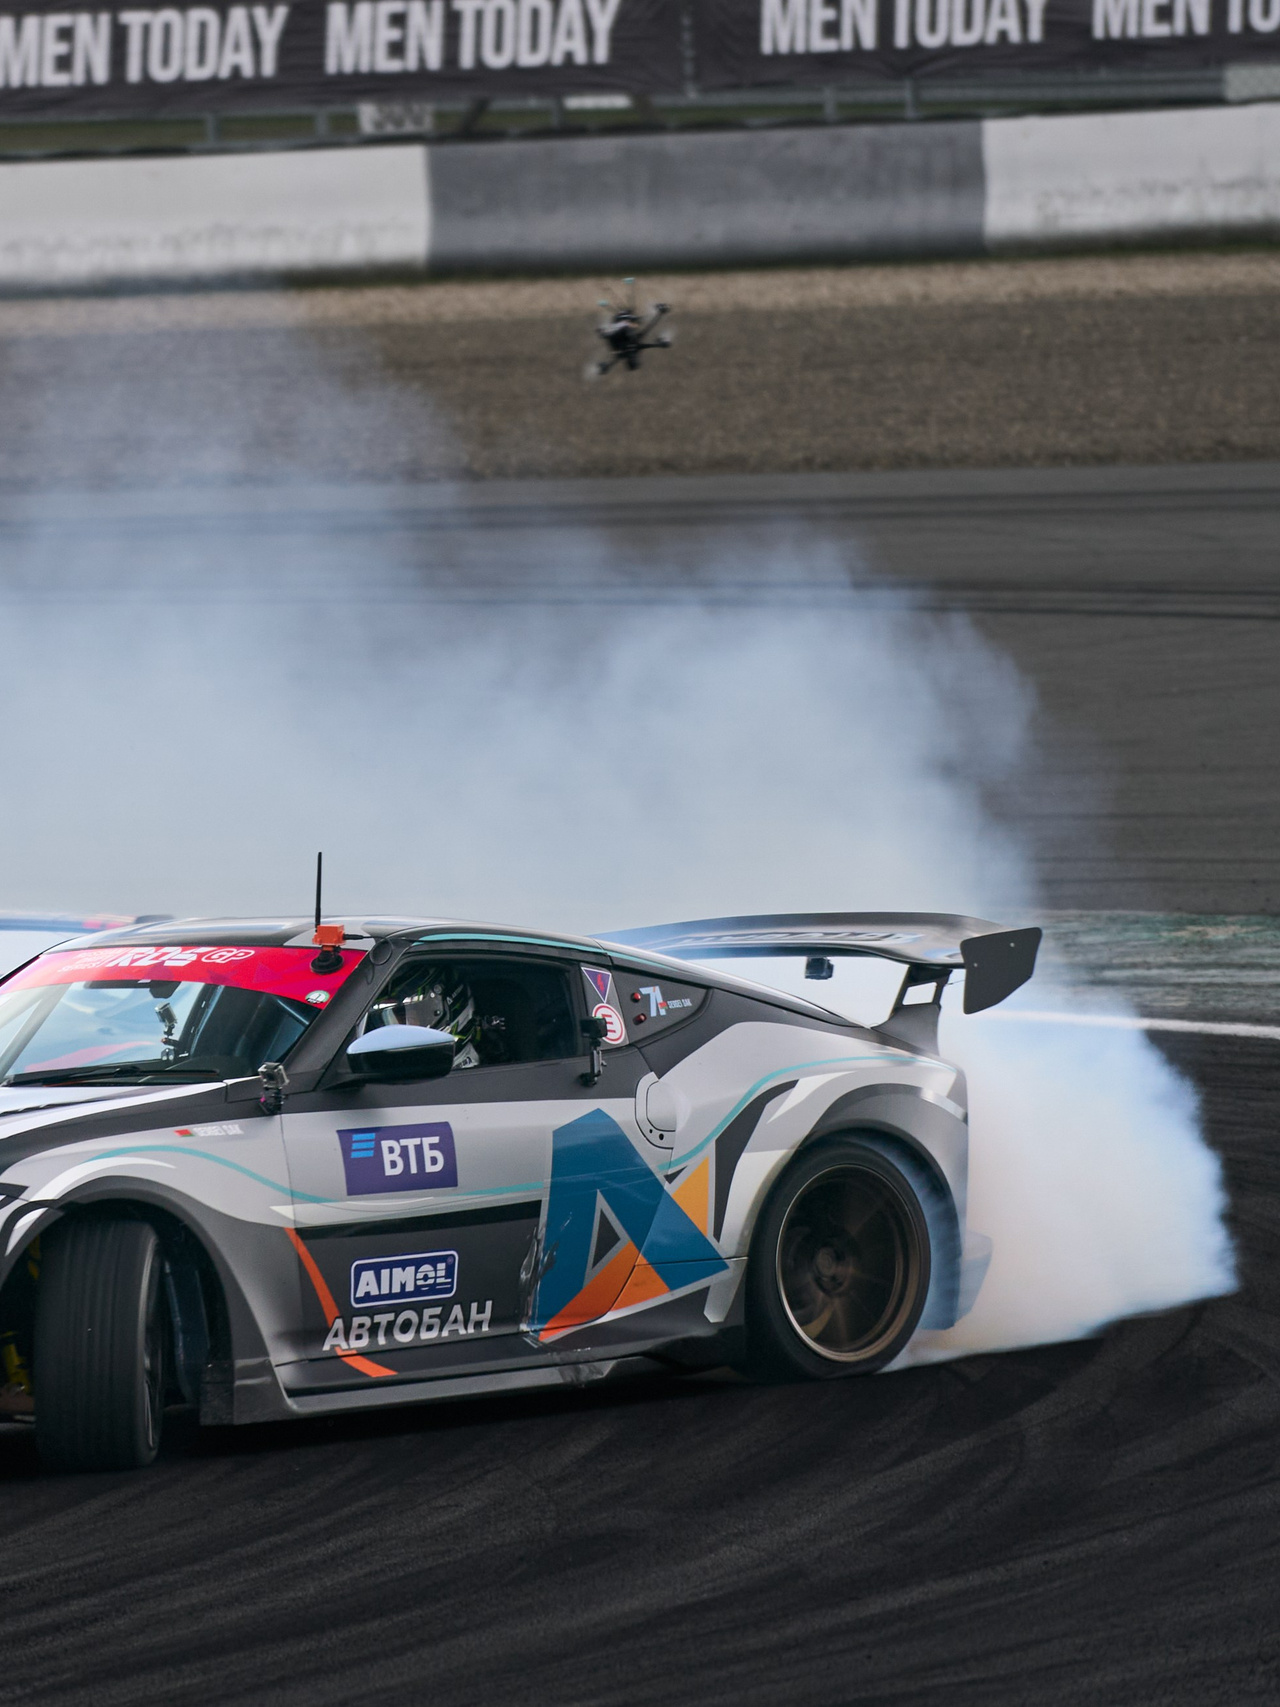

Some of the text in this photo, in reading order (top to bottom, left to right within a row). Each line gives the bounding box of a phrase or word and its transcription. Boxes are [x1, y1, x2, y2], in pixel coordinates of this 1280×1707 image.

[120, 5, 287, 83] TODAY
[325, 0, 620, 75] MEN TODAY
[760, 0, 877, 55] MEN
[380, 1136, 445, 1176] ВТБ
[355, 1262, 452, 1298] AIMOL
[322, 1300, 493, 1351] АВТОБАН
